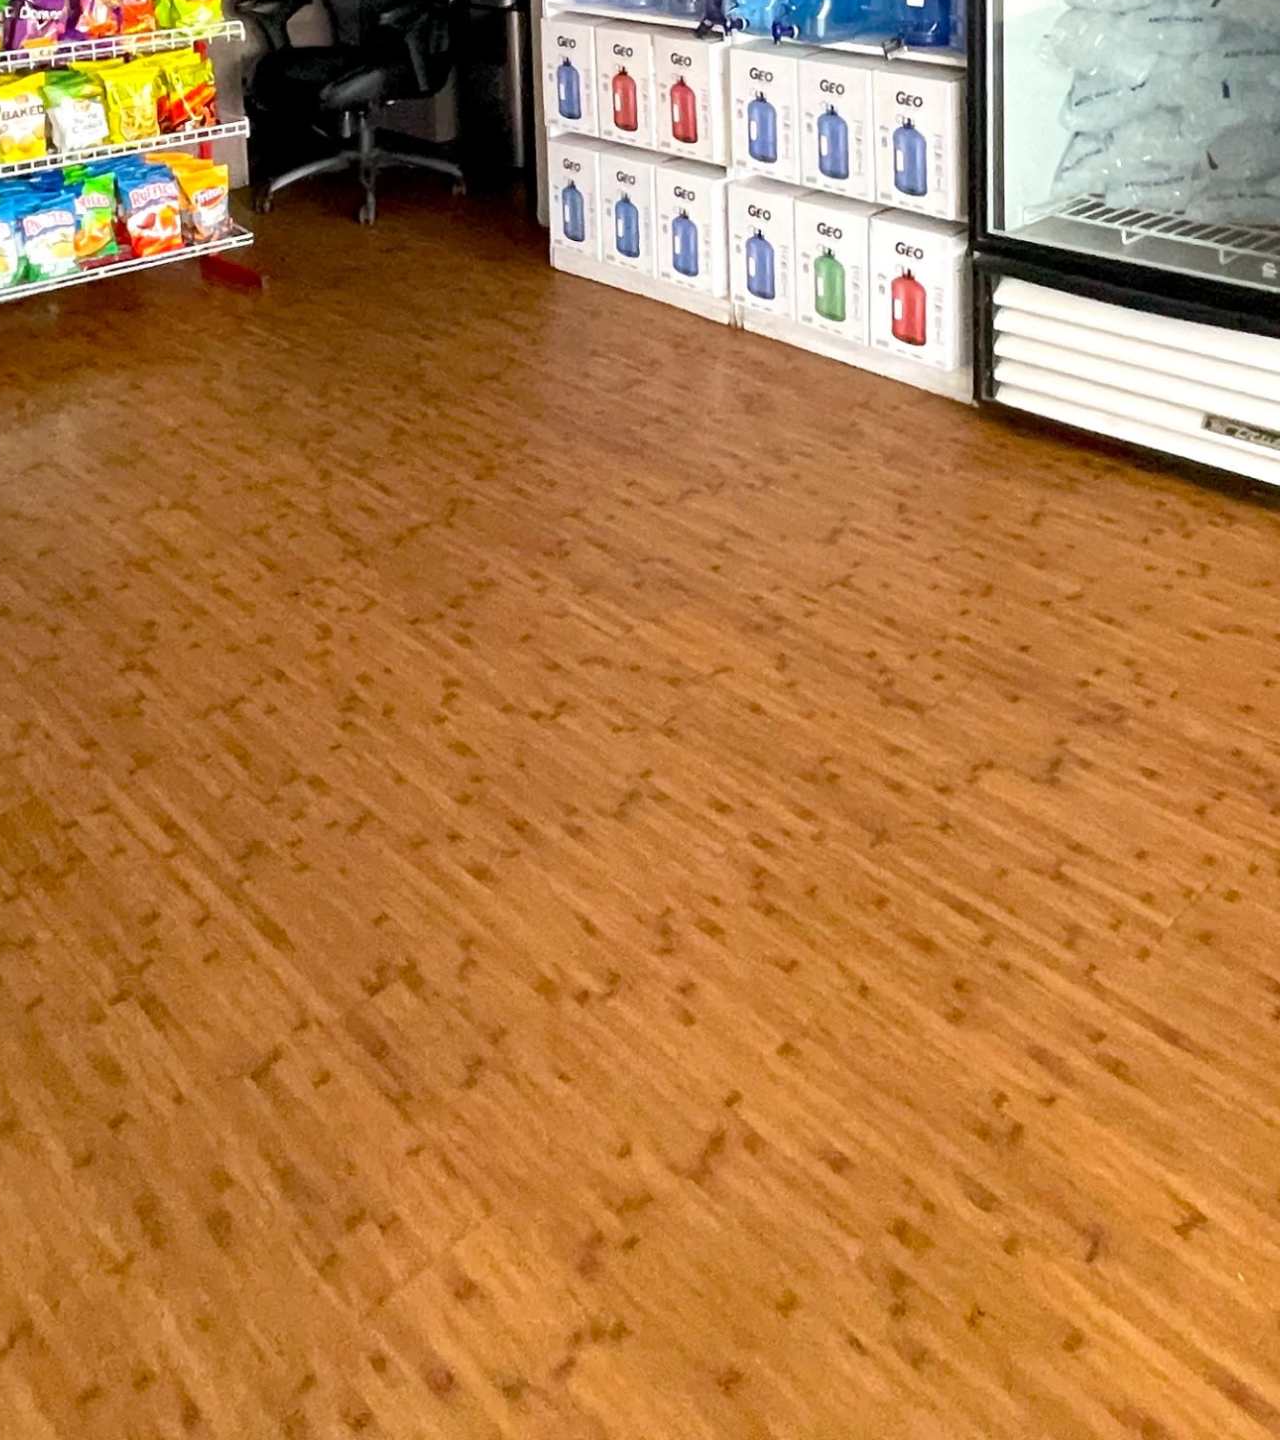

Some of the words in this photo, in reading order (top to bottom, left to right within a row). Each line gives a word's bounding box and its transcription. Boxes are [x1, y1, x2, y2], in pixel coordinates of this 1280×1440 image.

[557, 36, 577, 49] GEO
[613, 44, 633, 58] GEO
[670, 53, 692, 68] GEO
[749, 67, 773, 83] GEO
[819, 79, 845, 95] GEO
[895, 91, 923, 108] GEO
[1, 105, 45, 121] BAKED
[562, 158, 581, 173] GEO
[616, 171, 636, 186] GEO
[674, 186, 696, 201] GEO
[748, 204, 772, 221] GEO
[816, 222, 842, 240] GEO
[895, 242, 924, 260] GEO
